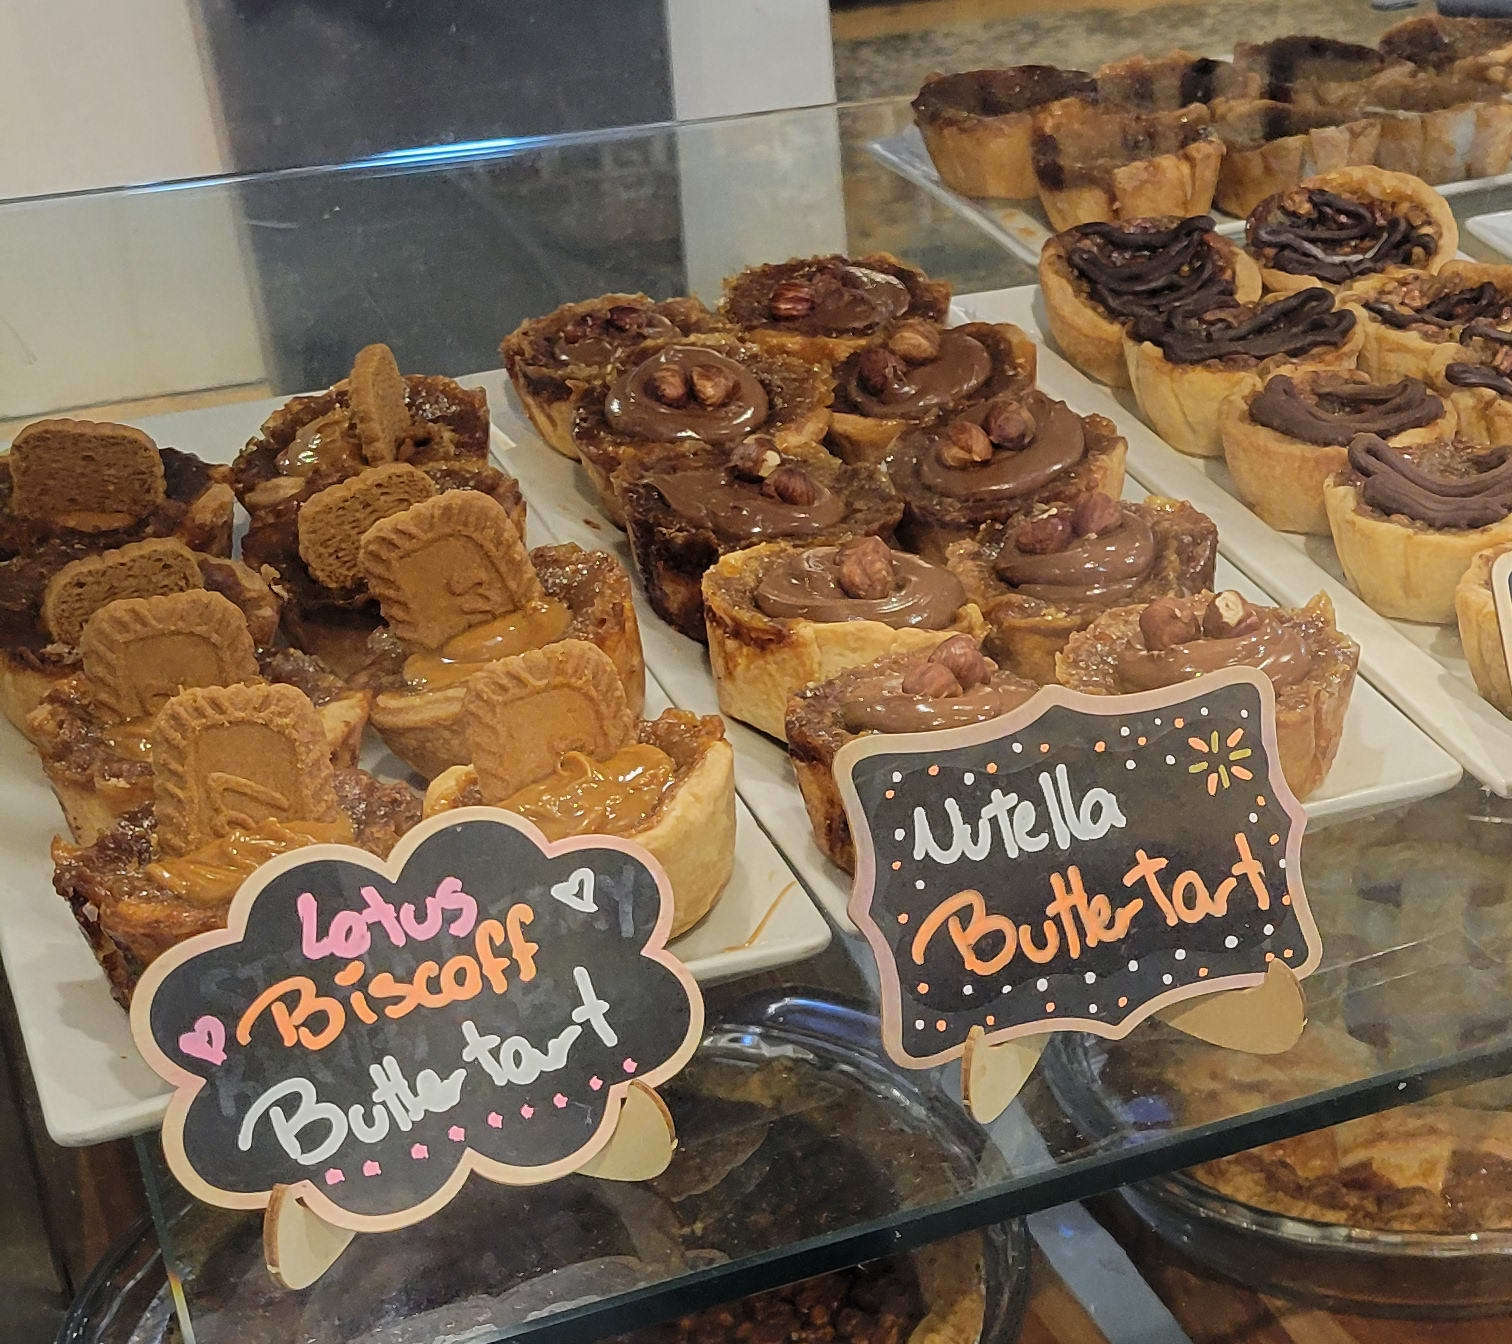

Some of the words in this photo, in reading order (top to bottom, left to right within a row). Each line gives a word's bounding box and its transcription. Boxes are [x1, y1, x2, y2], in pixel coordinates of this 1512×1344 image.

[912, 764, 1126, 863] Nutella
[297, 877, 478, 958] Lotus
[236, 903, 540, 1050] Biscoff
